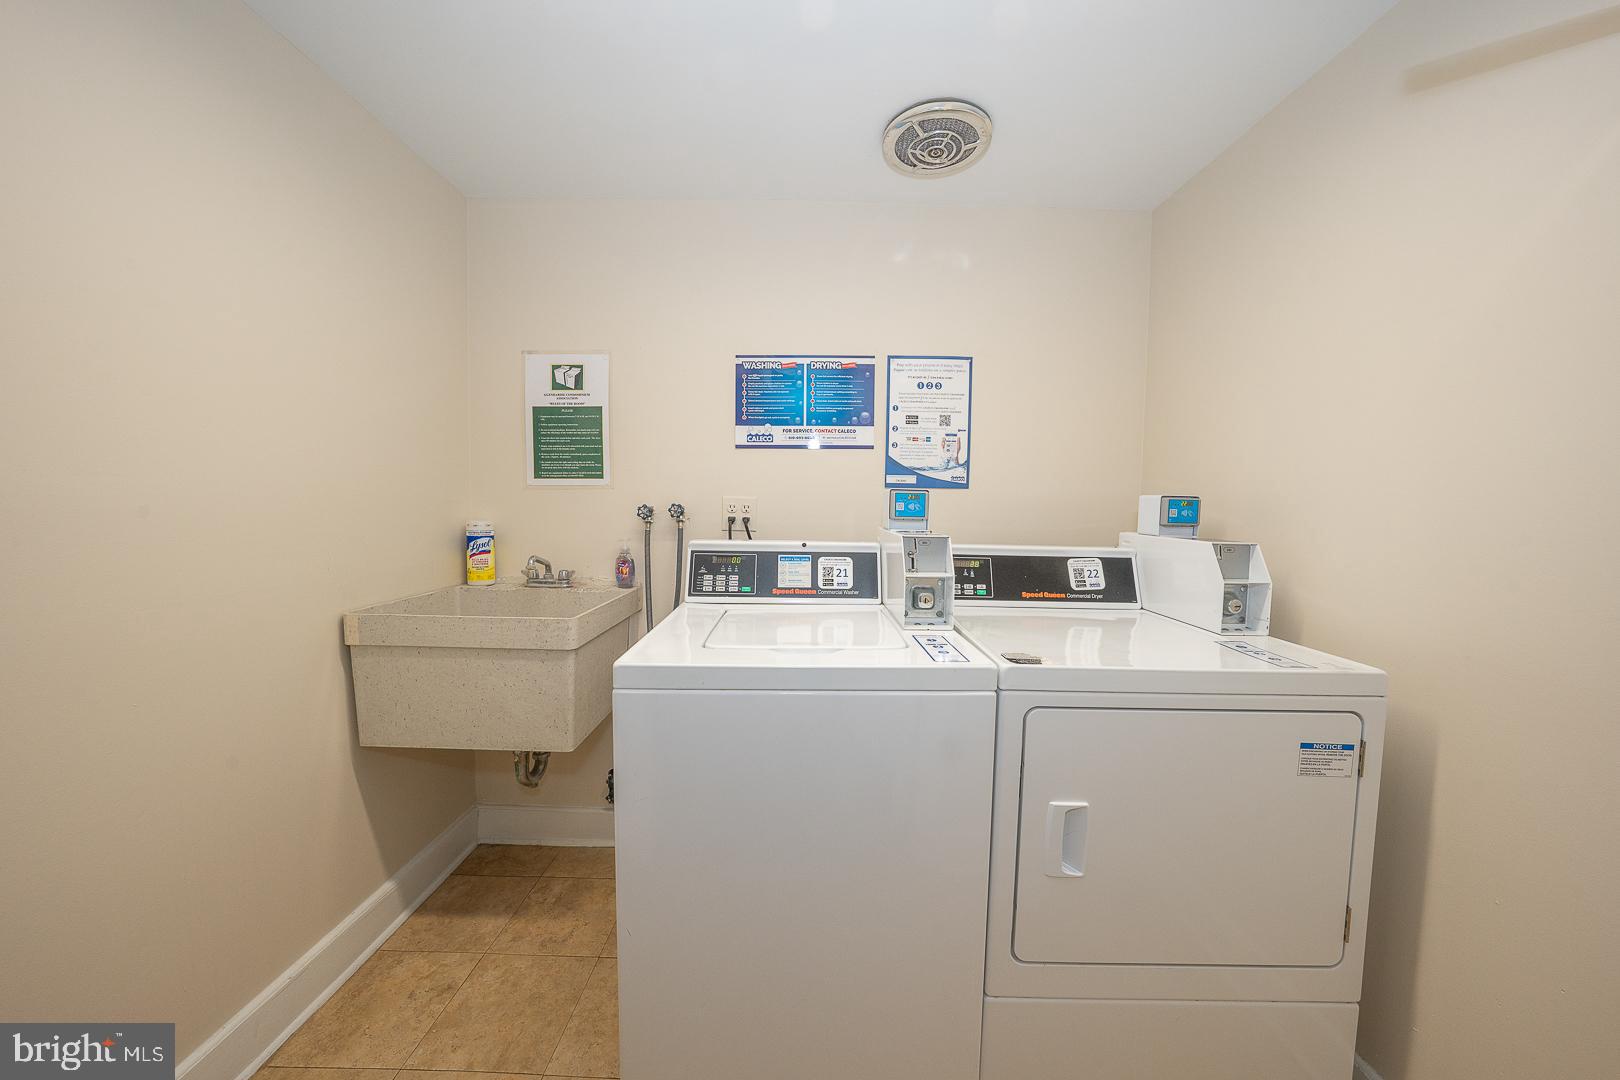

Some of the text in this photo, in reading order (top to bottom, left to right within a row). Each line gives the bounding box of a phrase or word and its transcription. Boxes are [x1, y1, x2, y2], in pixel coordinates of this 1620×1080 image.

[742, 361, 781, 369] WASHING
[810, 361, 842, 369] DRYING
[470, 539, 491, 552] Lysol
[836, 569, 848, 577] 21
[1087, 569, 1100, 578] 22
